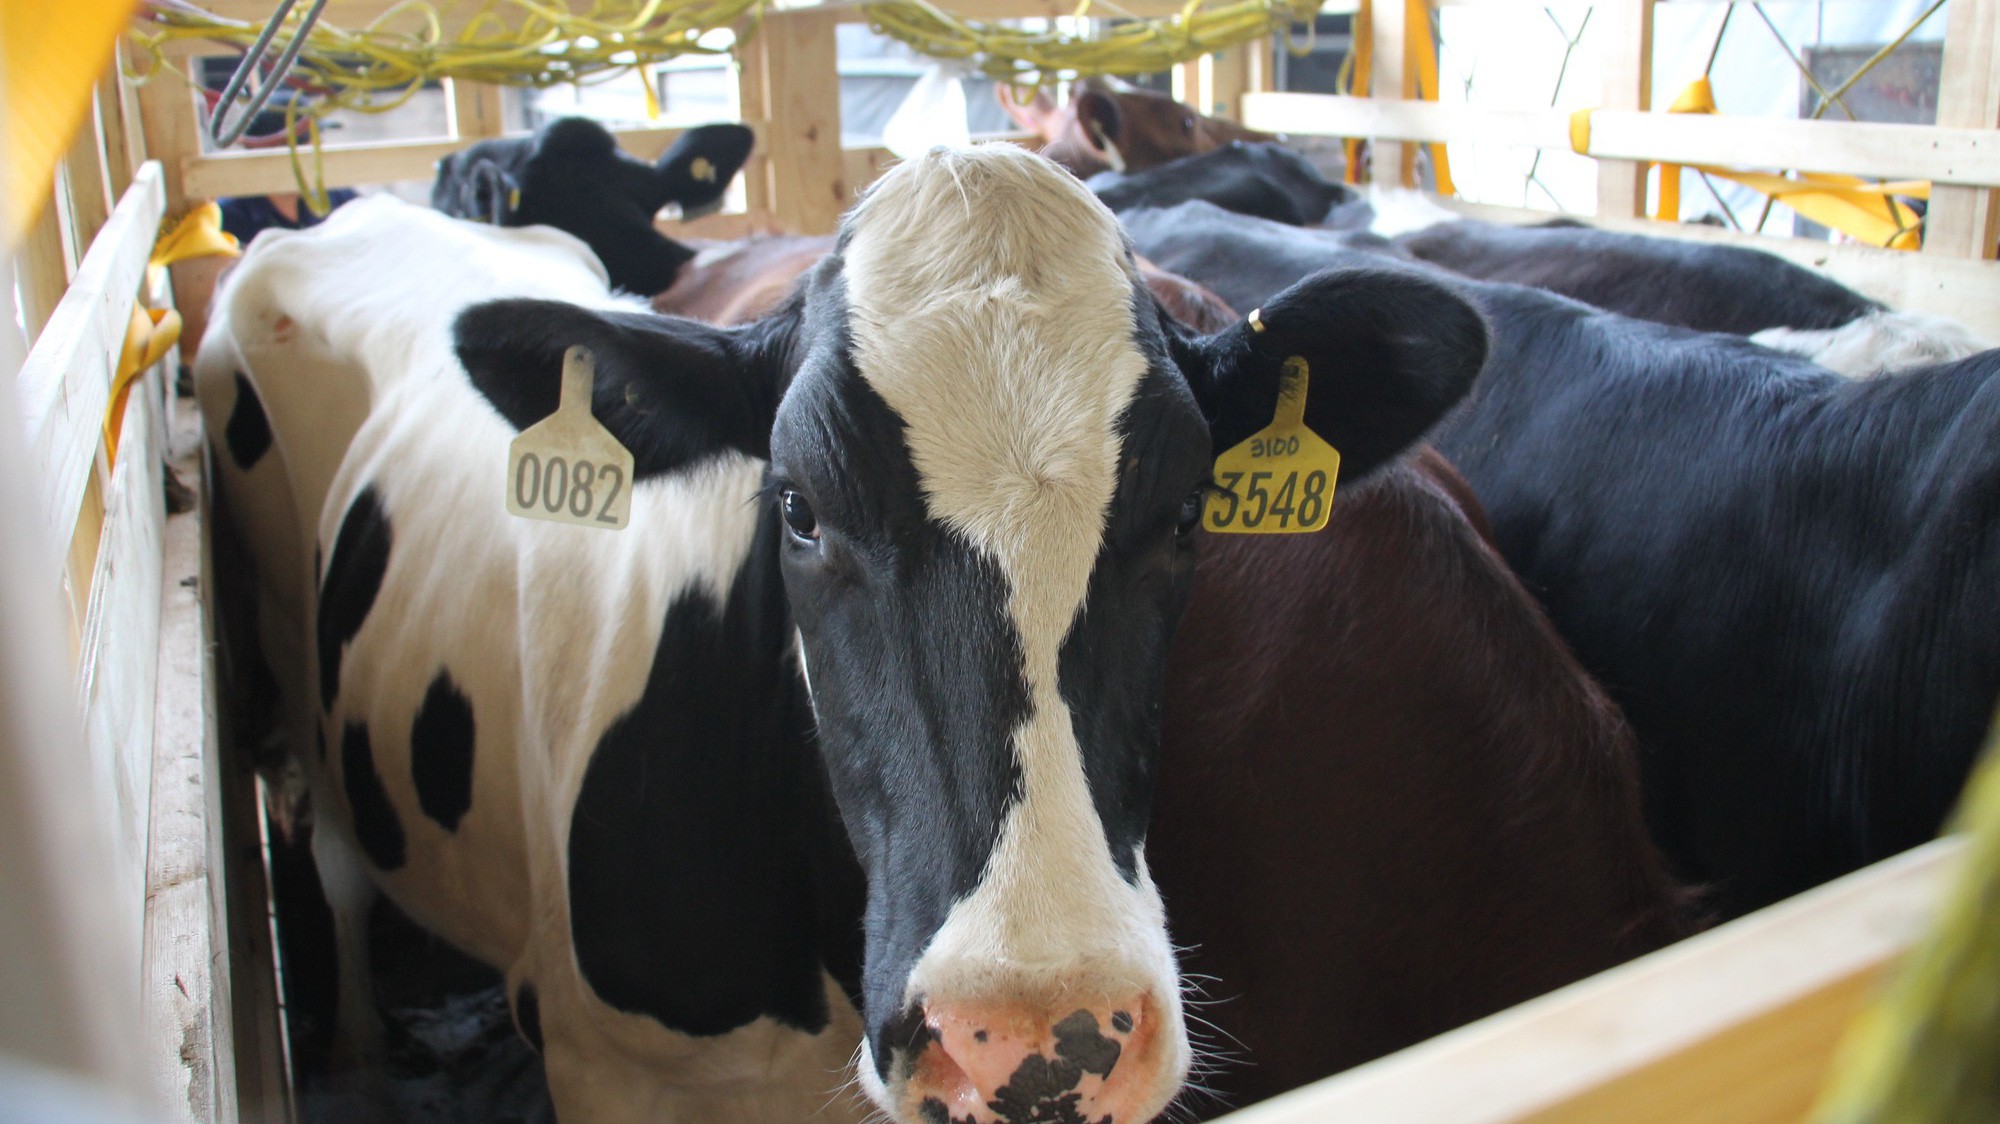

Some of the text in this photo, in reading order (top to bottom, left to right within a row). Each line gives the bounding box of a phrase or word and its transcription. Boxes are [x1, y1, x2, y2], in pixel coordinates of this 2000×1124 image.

[1251, 436, 1299, 458] 3100
[516, 452, 623, 524] 0082
[1212, 470, 1326, 528] 3548
